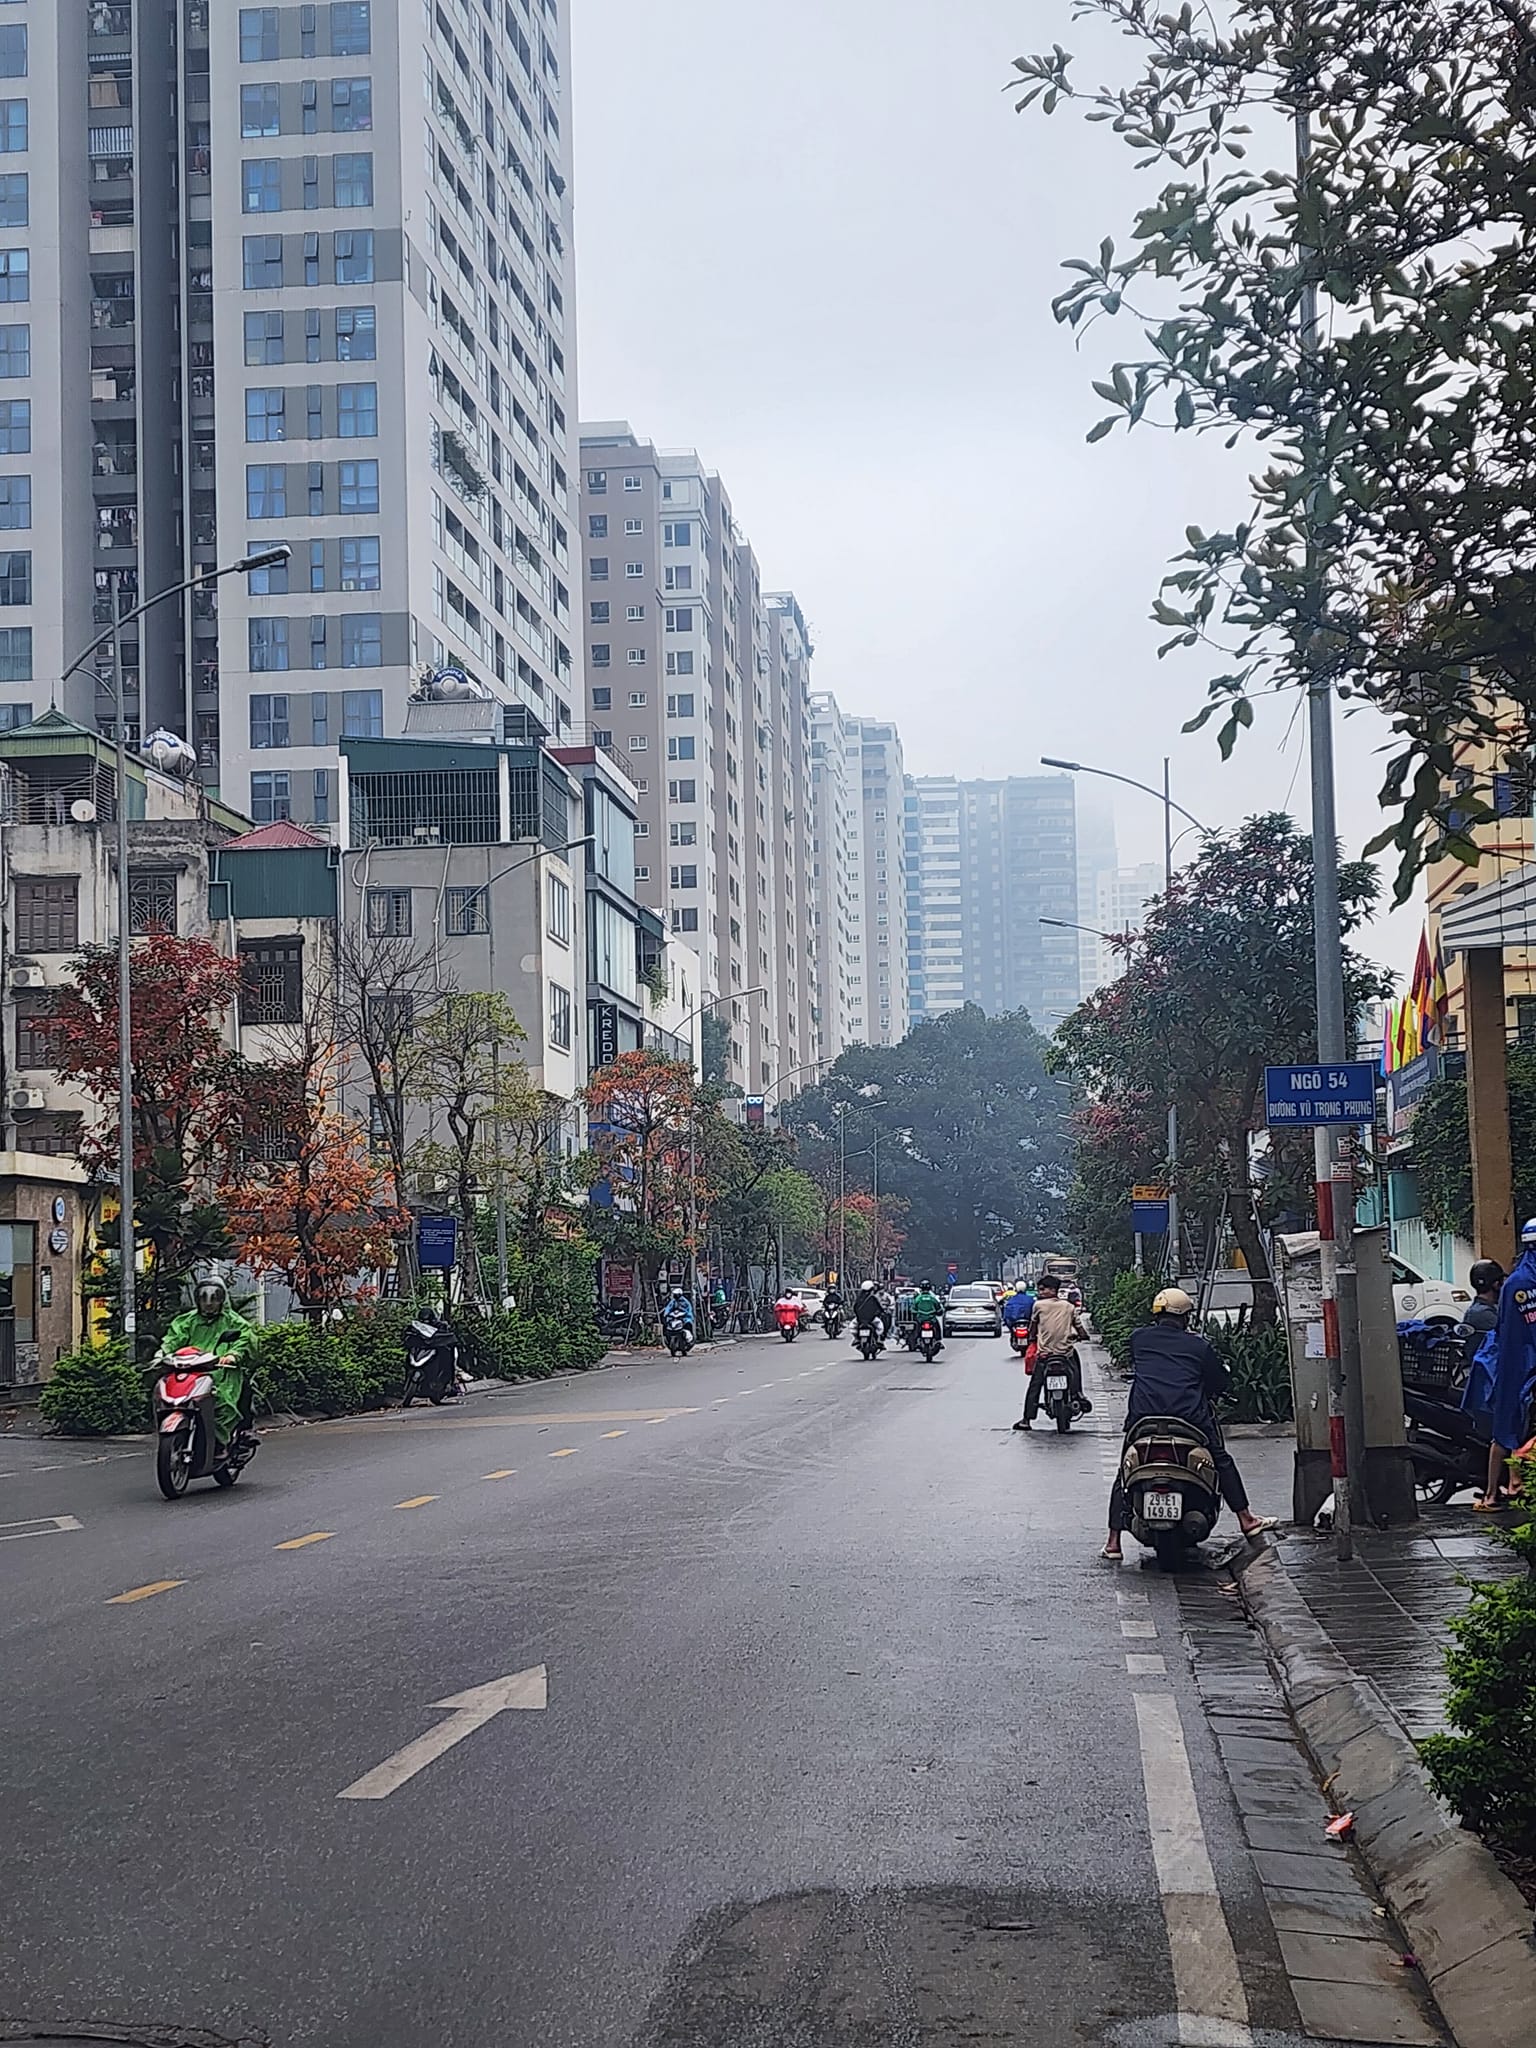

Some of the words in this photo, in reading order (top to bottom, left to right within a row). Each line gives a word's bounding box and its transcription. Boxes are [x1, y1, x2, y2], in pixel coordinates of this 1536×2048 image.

[1291, 1071, 1322, 1089] NGÕ
[1328, 1072, 1348, 1089] 54
[1269, 1099, 1297, 1117] ĐƯỜNG
[1299, 1099, 1312, 1117] VŨ
[1315, 1101, 1341, 1118] TRỌNG
[1344, 1100, 1372, 1117] PHỤNG
[1147, 1506, 1179, 1518] 149.63
